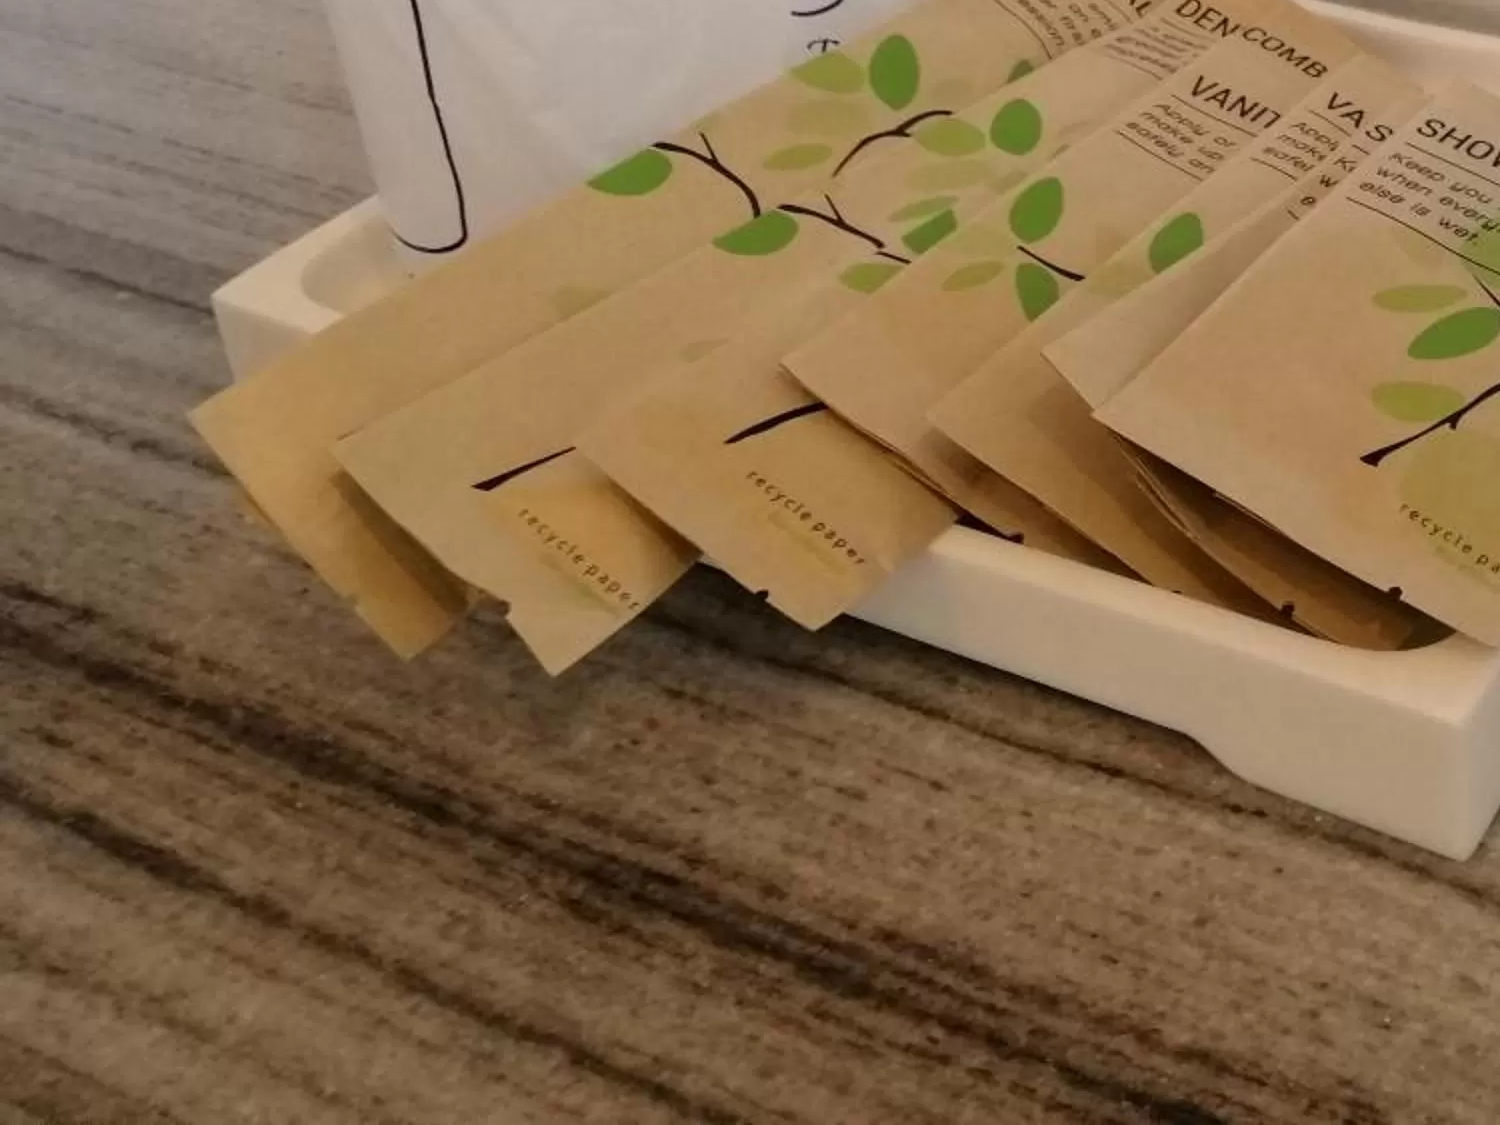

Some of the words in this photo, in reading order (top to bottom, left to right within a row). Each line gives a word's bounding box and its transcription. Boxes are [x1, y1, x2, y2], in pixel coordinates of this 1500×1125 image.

[1241, 26, 1329, 78] COMB
[1359, 181, 1406, 205] else
[1409, 202, 1432, 217] is
[1376, 166, 1434, 196] when
[1389, 152, 1446, 182] Keep
[1449, 181, 1495, 204] you
[746, 470, 812, 522] recycle
[811, 522, 865, 565] paper
[1399, 503, 1474, 554] recycle
[517, 507, 585, 565] recycle
[583, 563, 641, 610] paper
